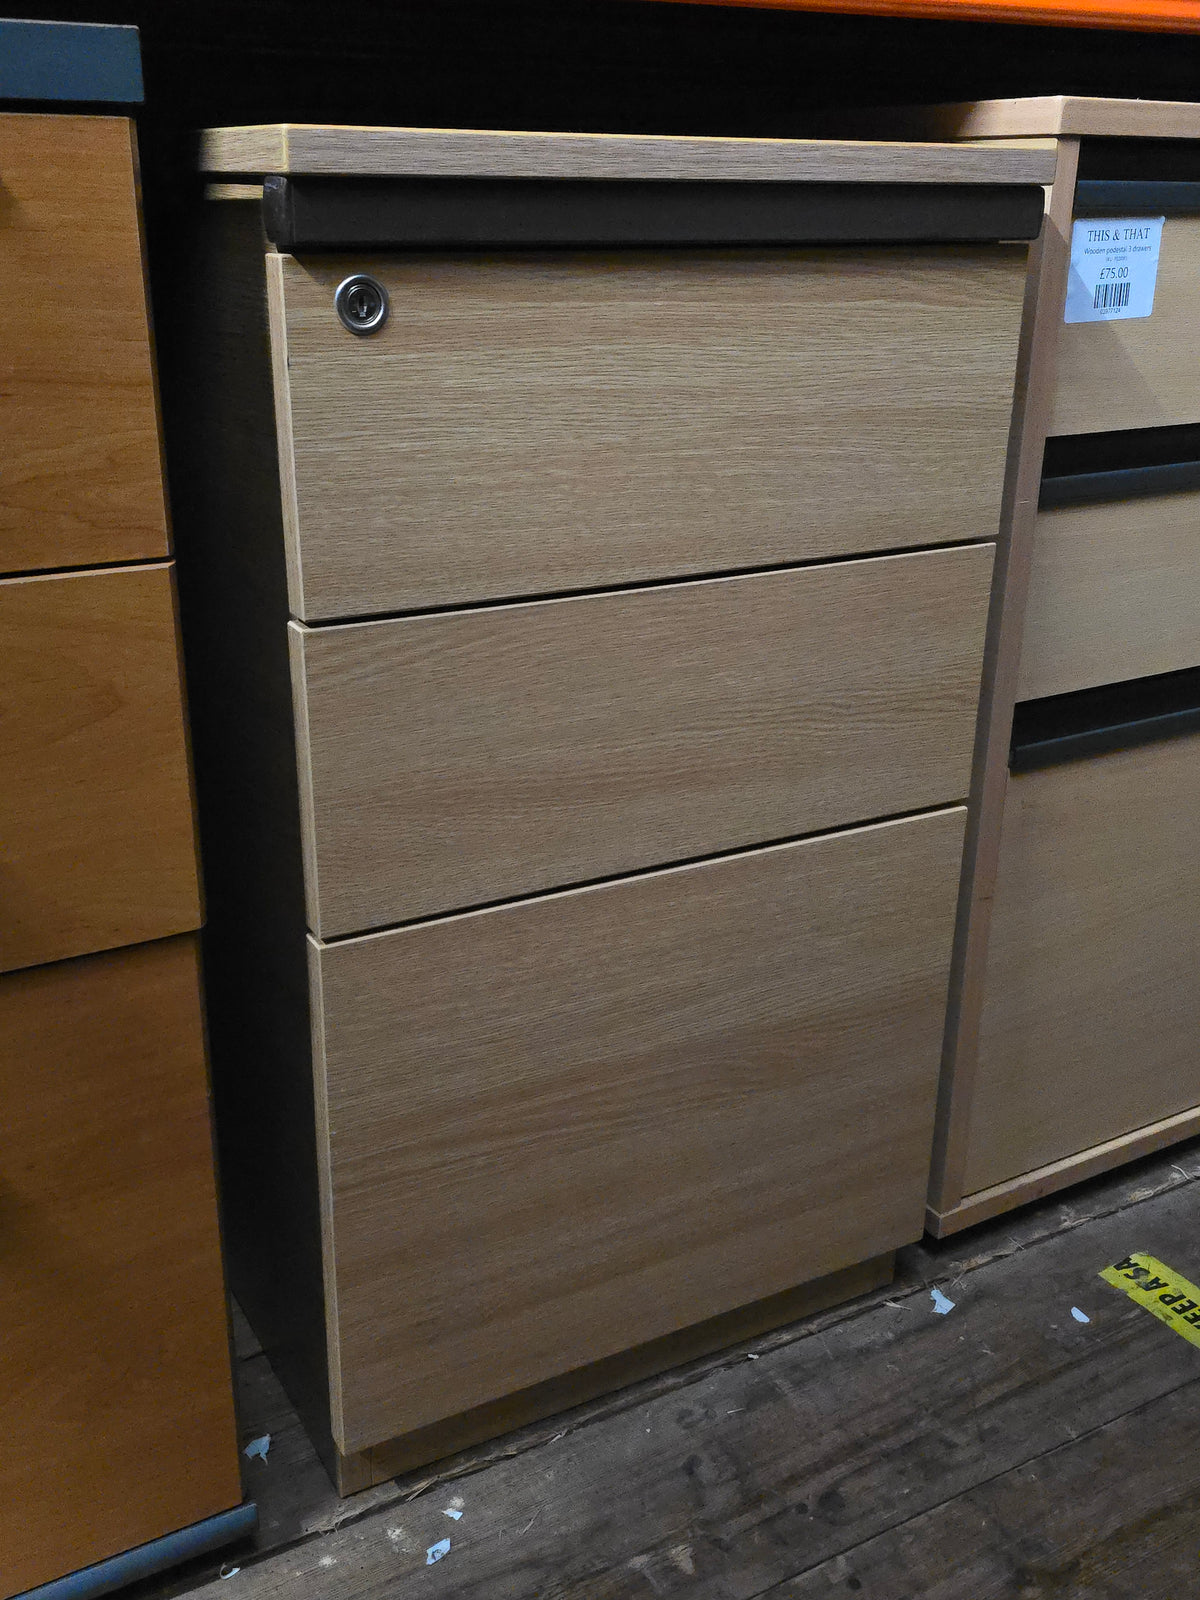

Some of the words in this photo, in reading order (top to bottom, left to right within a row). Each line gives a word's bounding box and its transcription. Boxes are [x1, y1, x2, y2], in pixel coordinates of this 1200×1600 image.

[1088, 229, 1110, 242] THIS
[1112, 229, 1121, 241] &
[1124, 227, 1151, 240] THAT
[1084, 247, 1105, 255] Wooden
[1106, 246, 1127, 255] pedestal
[1100, 266, 1129, 280] £75.00
[1145, 1276, 1169, 1292] A
